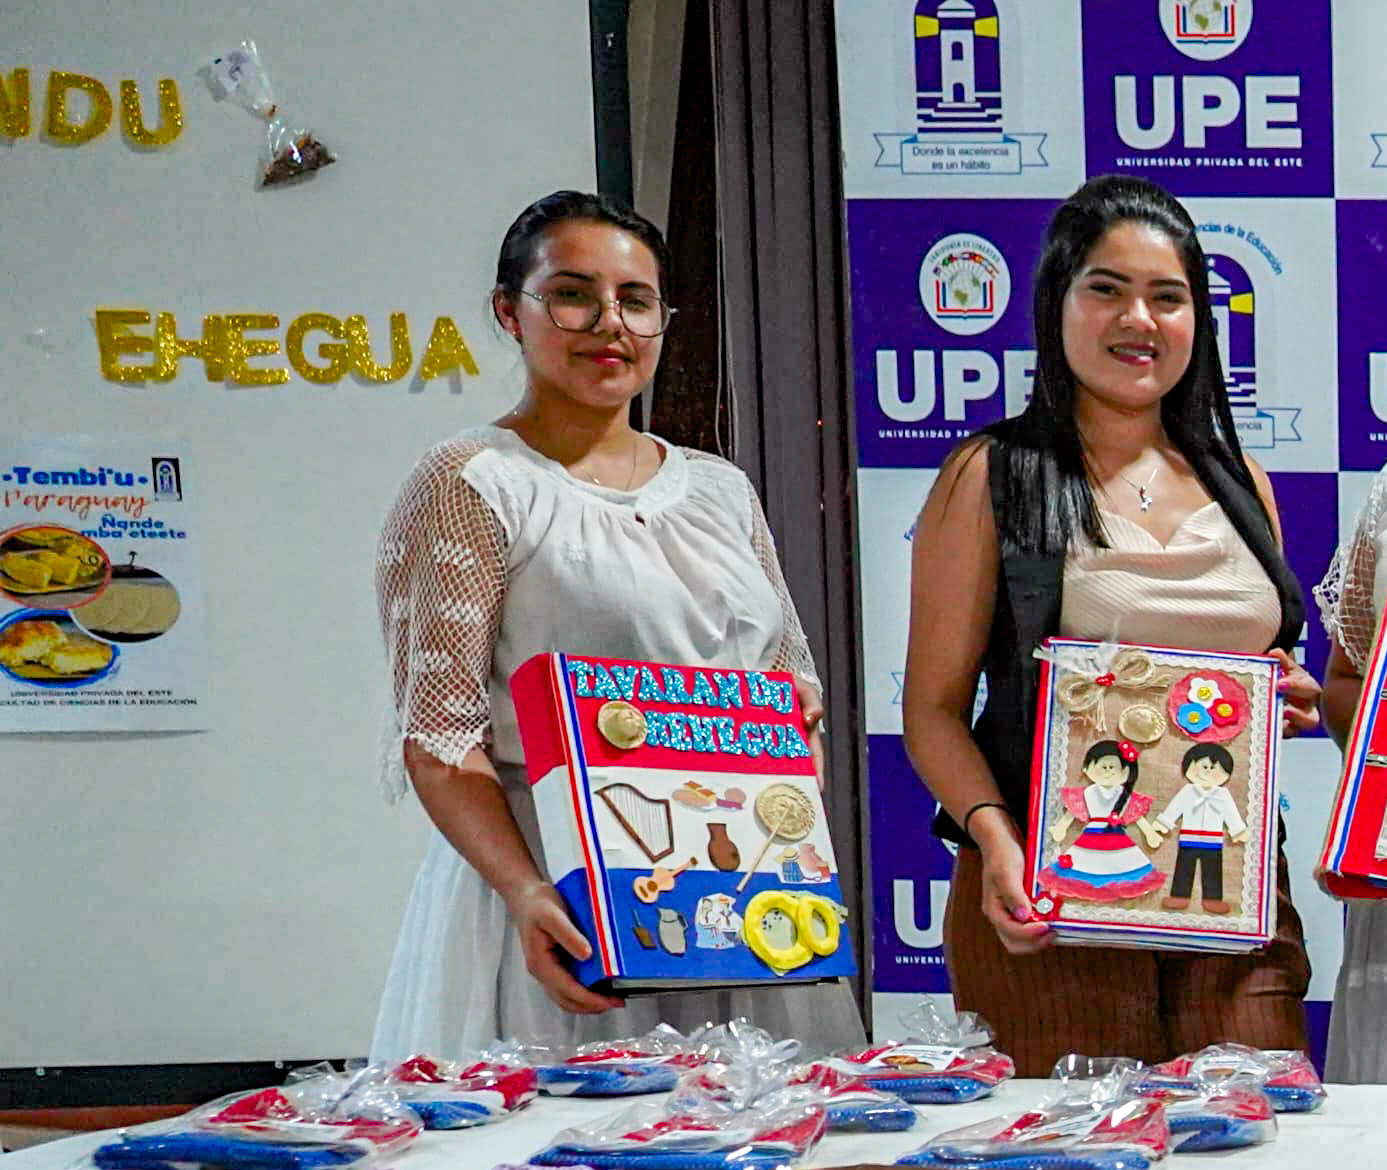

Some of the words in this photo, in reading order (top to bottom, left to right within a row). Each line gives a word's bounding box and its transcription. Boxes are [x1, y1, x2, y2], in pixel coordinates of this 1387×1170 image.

[1115, 75, 1303, 150] UPE
[1116, 157, 1191, 167] UNIVERSIDAD
[1196, 157, 1244, 167] PRIVADA
[1248, 158, 1269, 167] DEL
[1274, 157, 1302, 167] ESTE
[96, 310, 480, 384] EHEGUA
